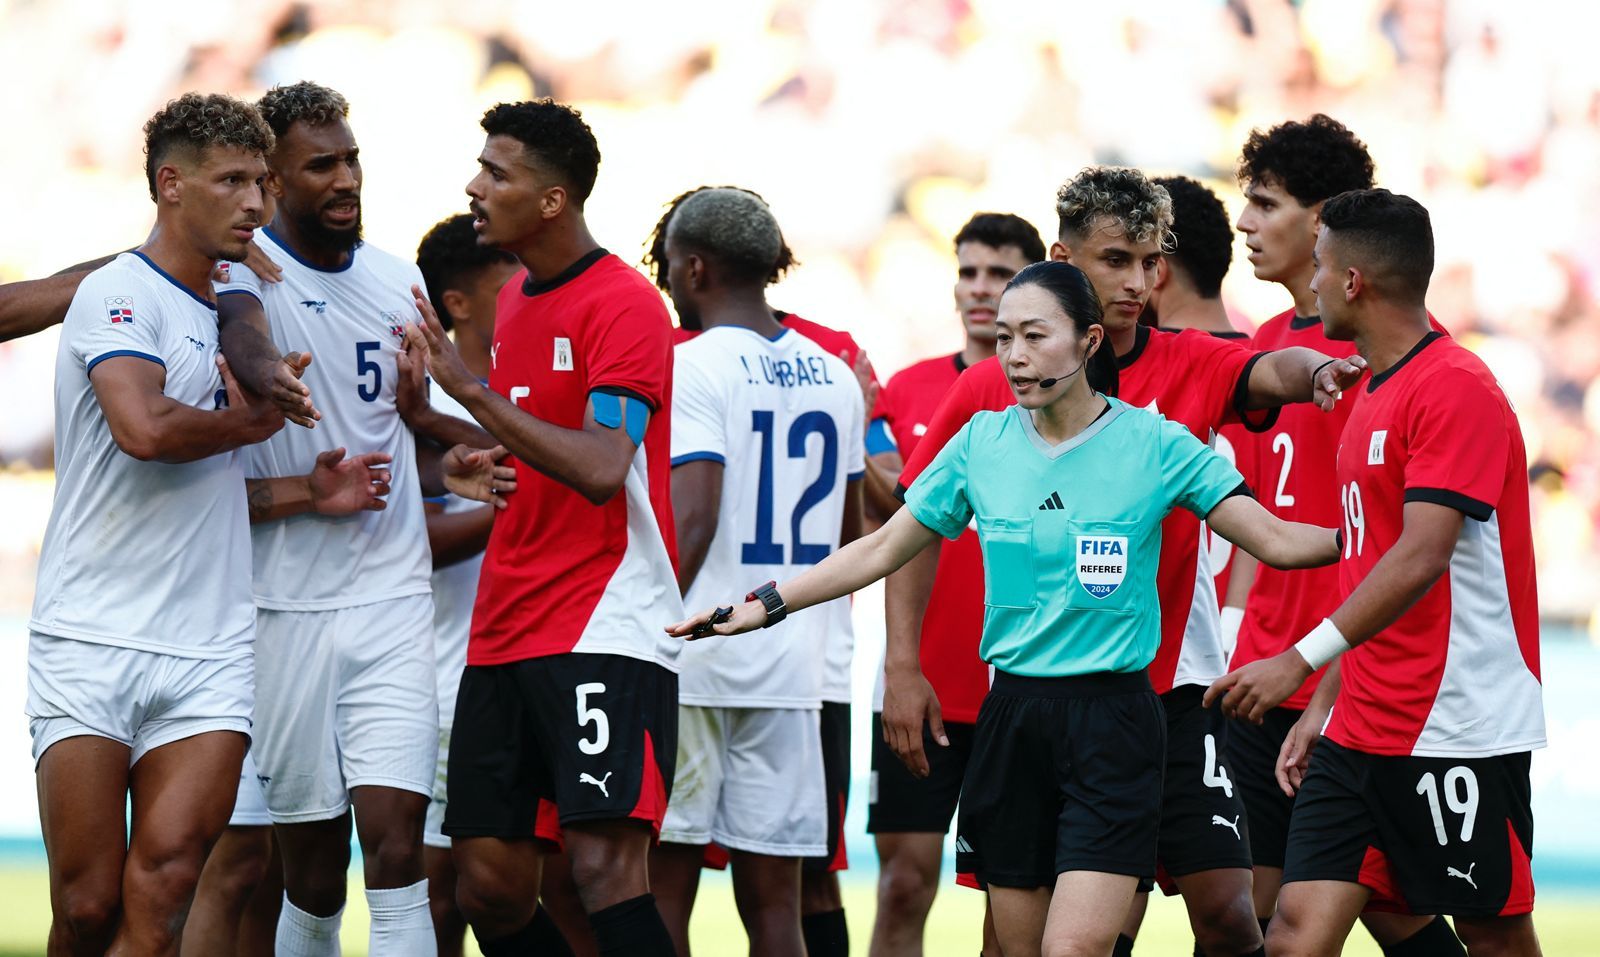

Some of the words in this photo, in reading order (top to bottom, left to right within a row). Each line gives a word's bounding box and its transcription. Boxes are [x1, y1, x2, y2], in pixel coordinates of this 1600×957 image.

[355, 341, 382, 403] 5
[741, 410, 838, 565] 12
[1272, 432, 1295, 507] 2
[1081, 540, 1123, 556] FIFA
[1341, 481, 1365, 560] 19
[1080, 564, 1123, 574] REFEREE
[1091, 585, 1110, 593] 2024
[575, 682, 610, 755] 5
[1203, 734, 1234, 798] 4
[1415, 765, 1480, 846] 19
